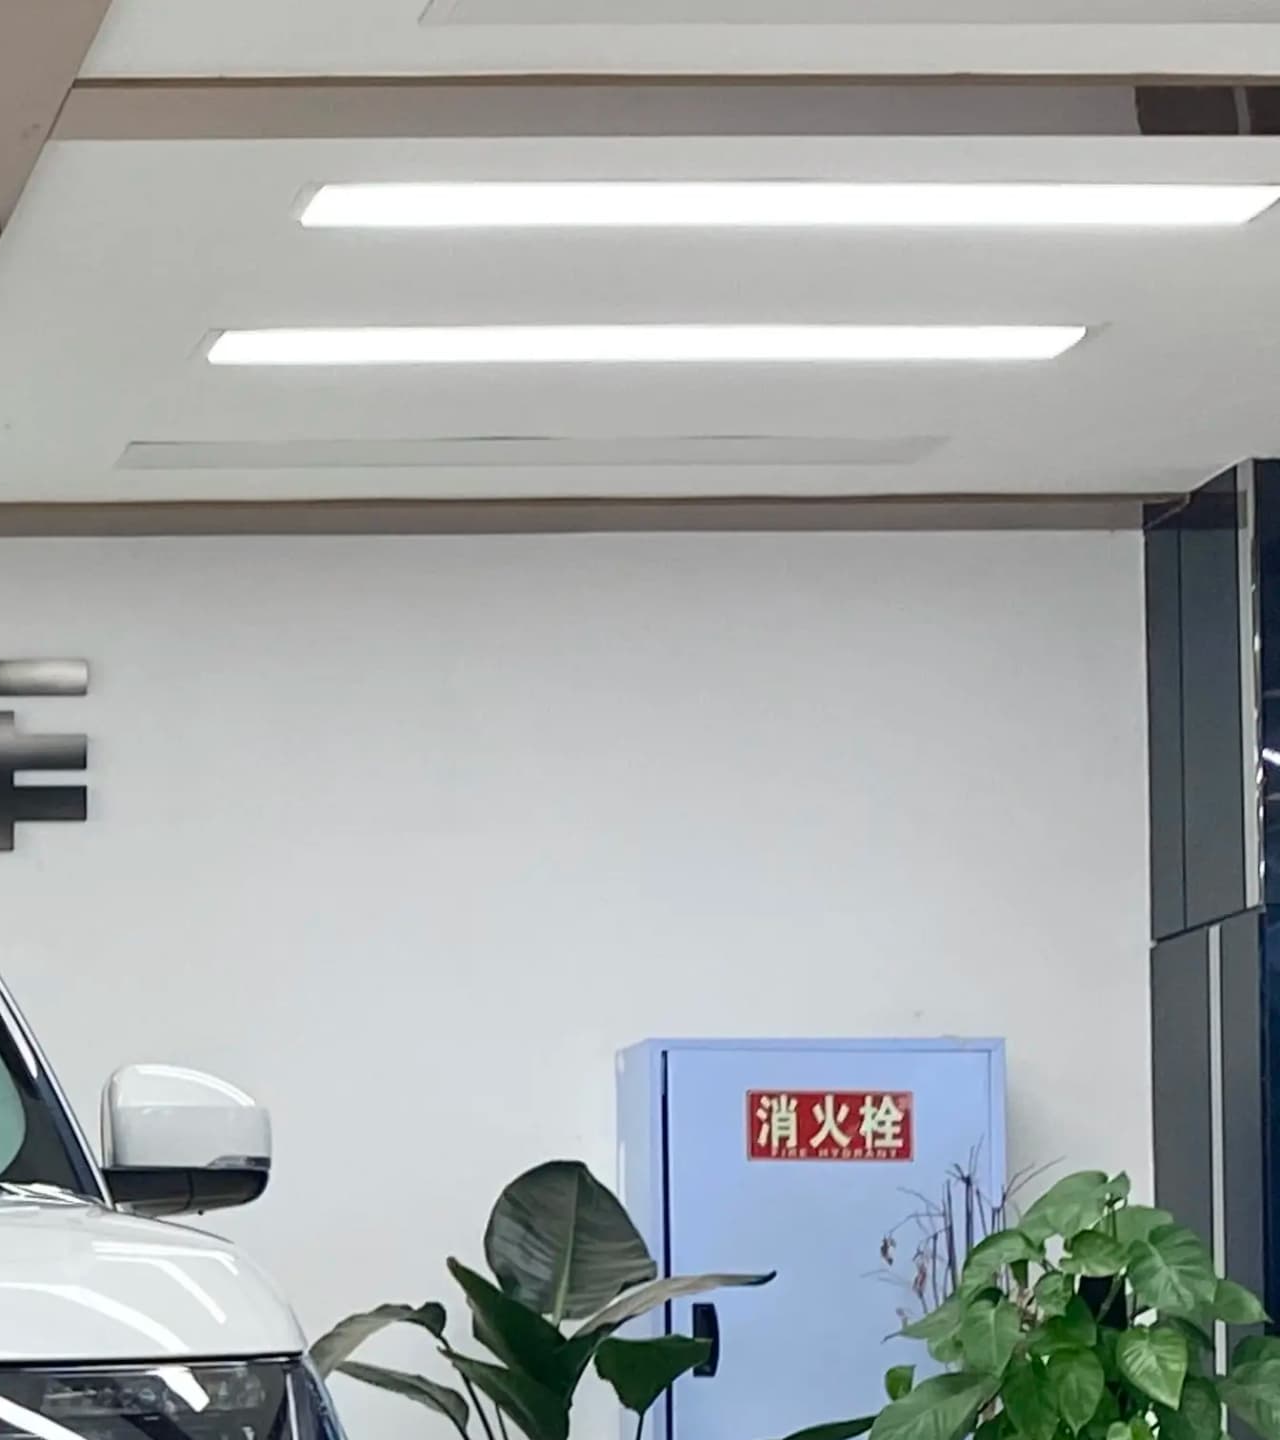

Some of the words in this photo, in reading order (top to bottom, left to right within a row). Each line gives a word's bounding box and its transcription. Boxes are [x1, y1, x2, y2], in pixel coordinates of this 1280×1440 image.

[756, 1094, 904, 1150] 消火栓
[771, 1148, 808, 1158] FIRE
